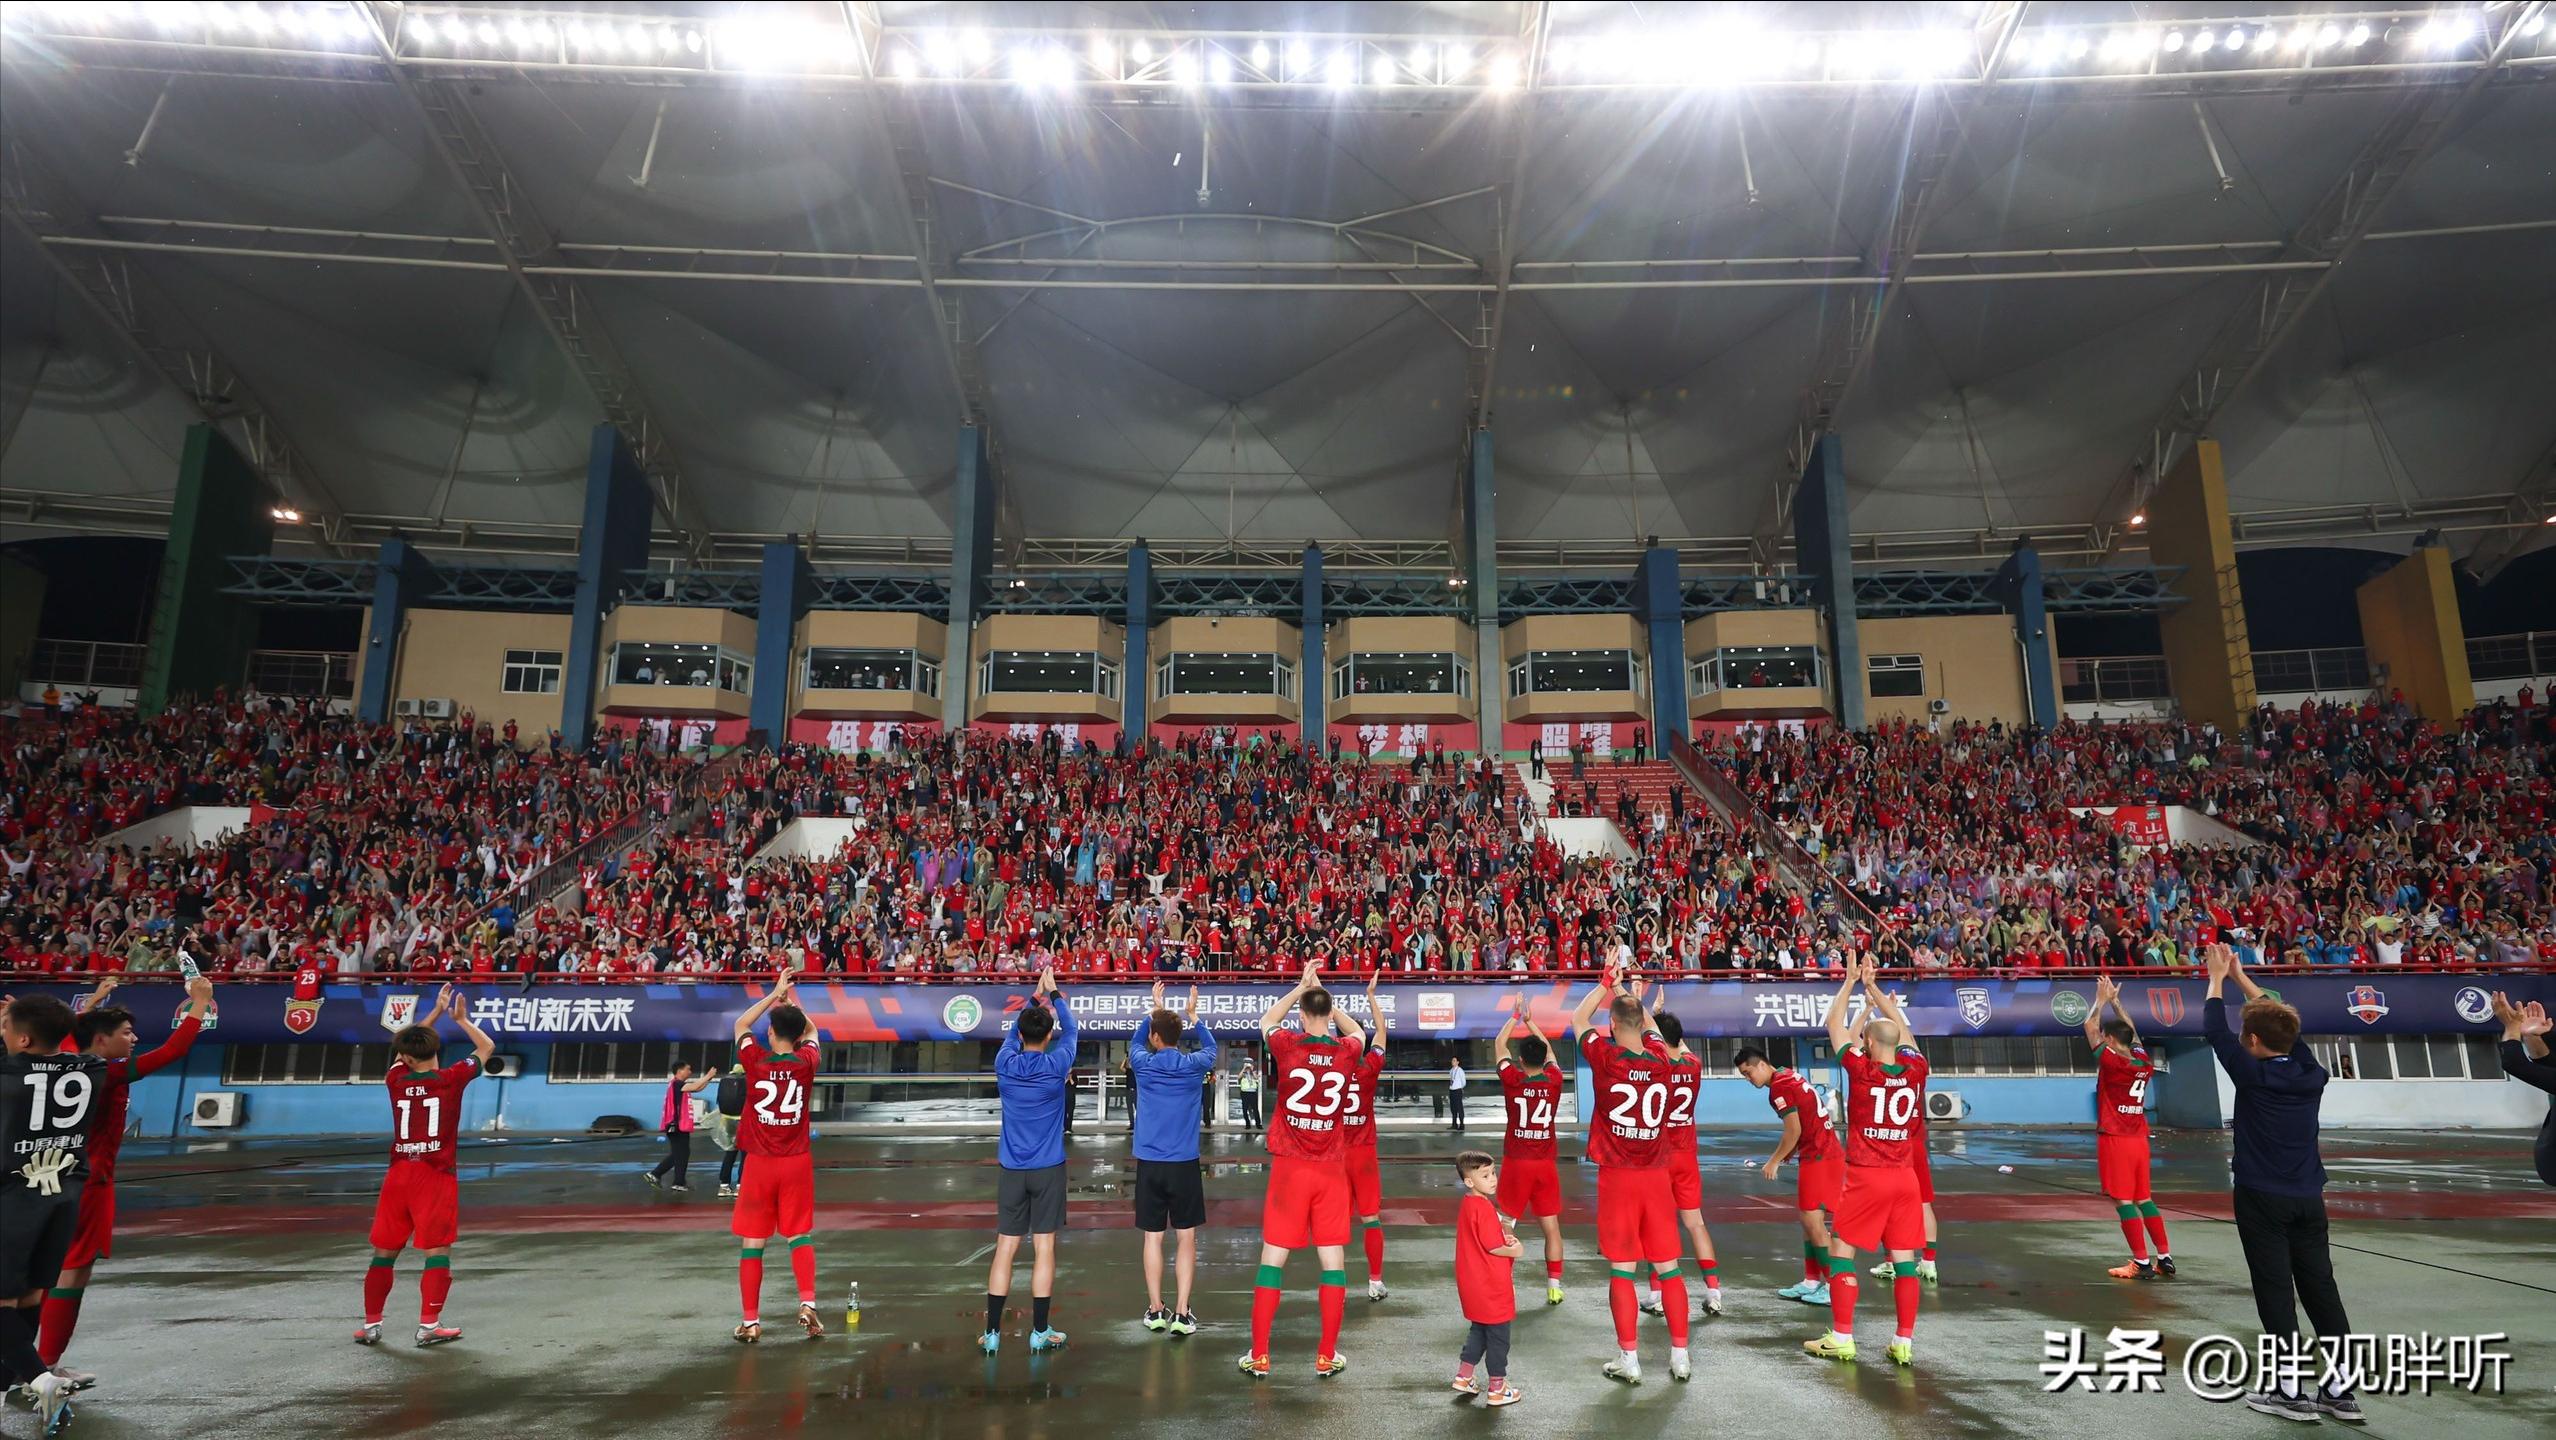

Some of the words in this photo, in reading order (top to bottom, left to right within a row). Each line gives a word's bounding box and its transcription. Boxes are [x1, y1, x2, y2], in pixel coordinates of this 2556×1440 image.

[301, 973, 316, 985] 29
[470, 997, 635, 1032] 共创新未来
[1309, 1054, 1333, 1066] SUNJIC
[1629, 1070, 1651, 1081] COVIC
[24, 1071, 92, 1131] 19
[754, 1080, 803, 1120] 24
[1286, 1068, 1345, 1115] 23
[1523, 1089, 1535, 1098] GAO
[2129, 1079, 2146, 1103] 4
[1514, 1097, 1552, 1129] 14
[1609, 1083, 1667, 1127] 20
[1870, 1087, 1916, 1126] 10
[397, 1097, 439, 1139] 11
[1287, 1115, 1334, 1131] 中原建业
[1515, 1129, 1550, 1139] 中原建业
[1612, 1125, 1660, 1140] 中原建业
[1864, 1128, 1908, 1140] 中原建业
[14, 1134, 84, 1154] 中原建业
